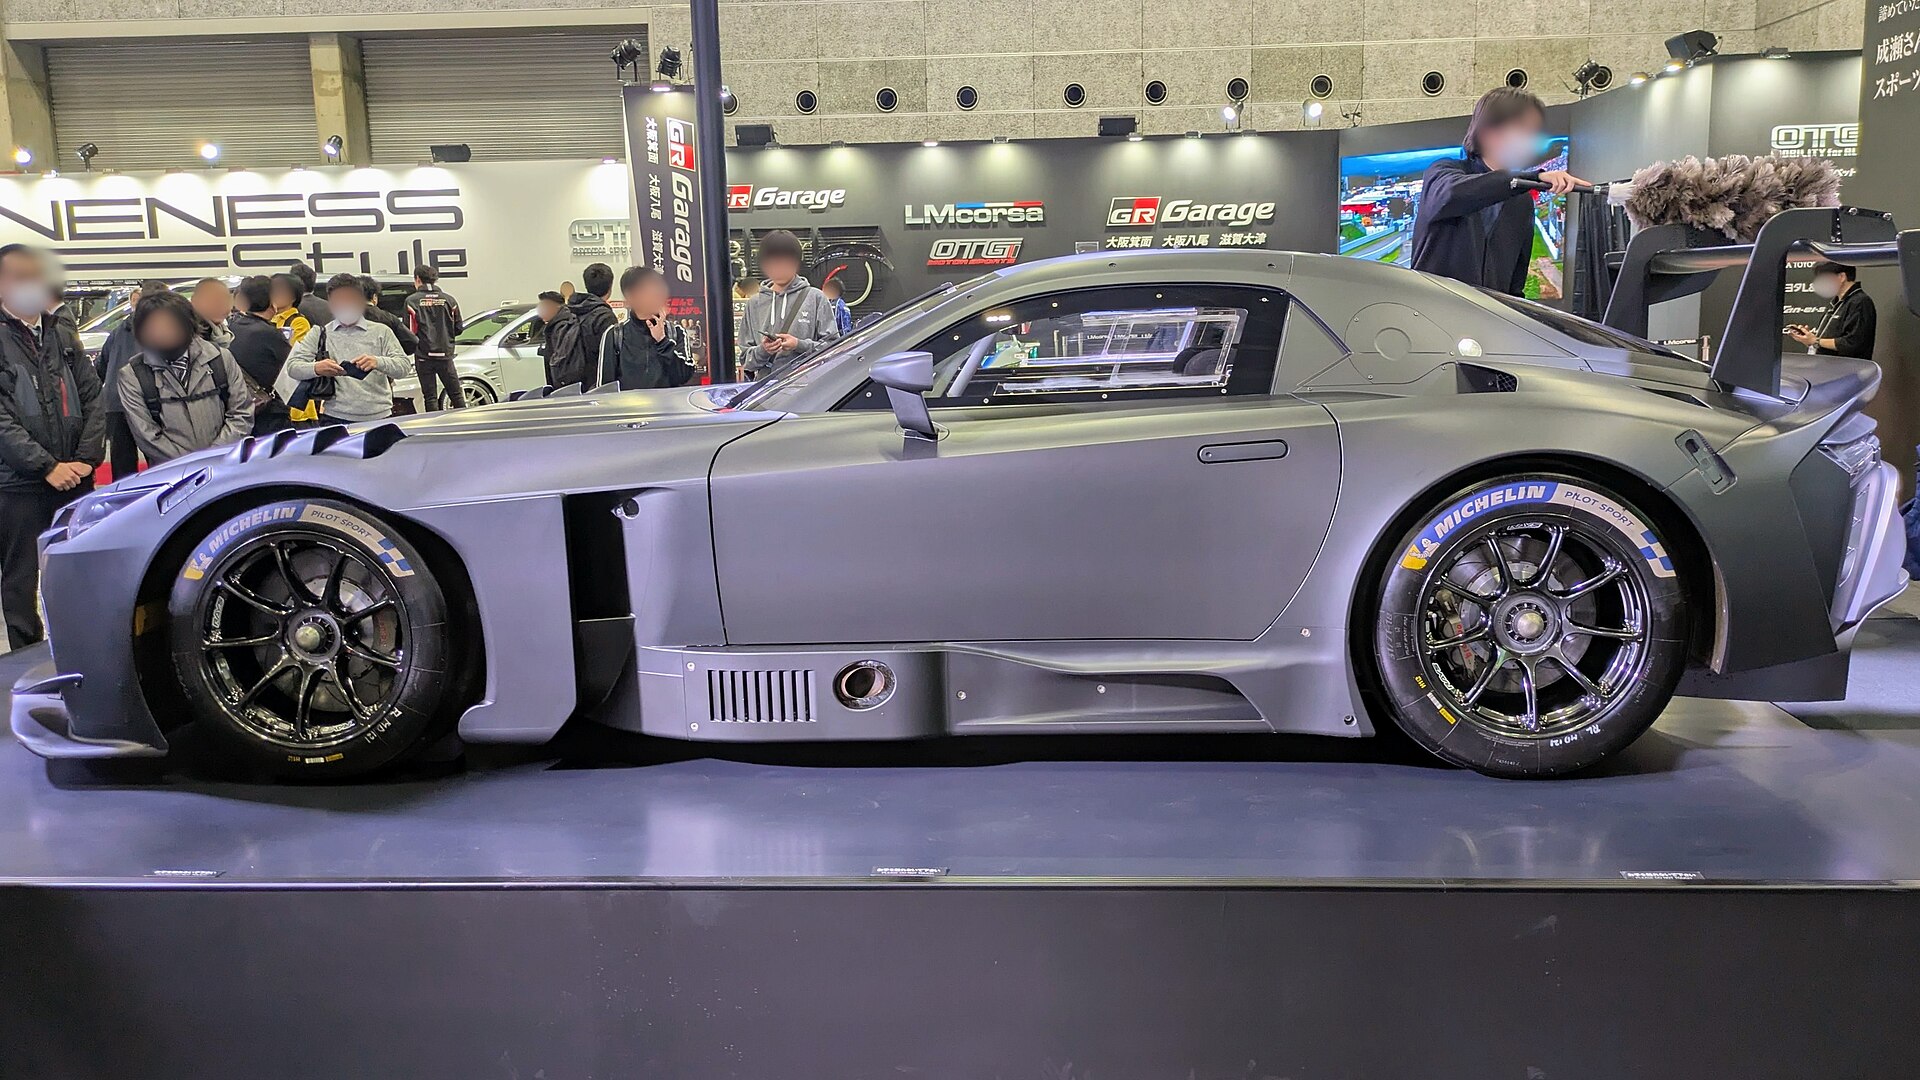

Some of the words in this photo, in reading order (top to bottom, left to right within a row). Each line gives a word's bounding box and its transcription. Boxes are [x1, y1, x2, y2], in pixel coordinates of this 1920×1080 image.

[648, 173, 663, 221] 大阪八尾
[753, 187, 846, 210] Garage
[904, 203, 1045, 225] LMcorsa
[1160, 199, 1276, 227] Garage
[670, 171, 694, 283] Garage
[1105, 235, 1154, 249] 大阪箕面
[1162, 234, 1210, 248] 大阪八尾
[1218, 232, 1267, 246] 滋賀大津
[208, 506, 298, 554] MICHELIN
[311, 509, 341, 523] PILOT
[339, 517, 373, 539] SPORT
[1433, 485, 1546, 539] MICHELIN
[1564, 491, 1600, 507] PILOT
[1599, 502, 1636, 528] SPORT
